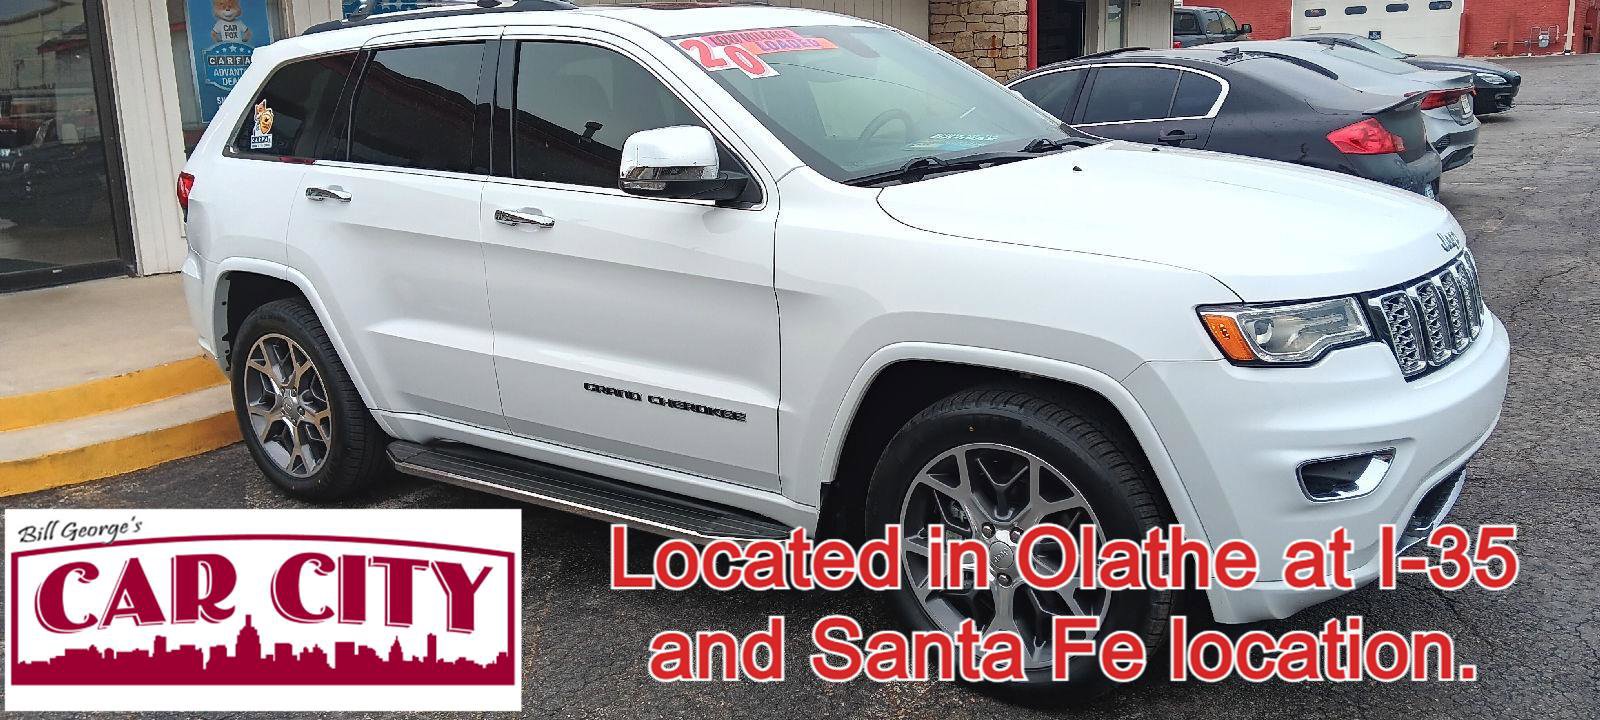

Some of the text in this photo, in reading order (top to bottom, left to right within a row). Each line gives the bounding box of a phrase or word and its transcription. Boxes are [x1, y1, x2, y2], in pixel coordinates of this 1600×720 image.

[223, 24, 238, 32] CAR
[709, 30, 794, 46] LOW MILEAGE
[755, 39, 821, 51] LOADED
[209, 57, 251, 65] CARFA
[213, 68, 245, 77] ADVANT
[222, 78, 239, 86] DEA
[583, 382, 747, 422] GRAND CHEROKEE
